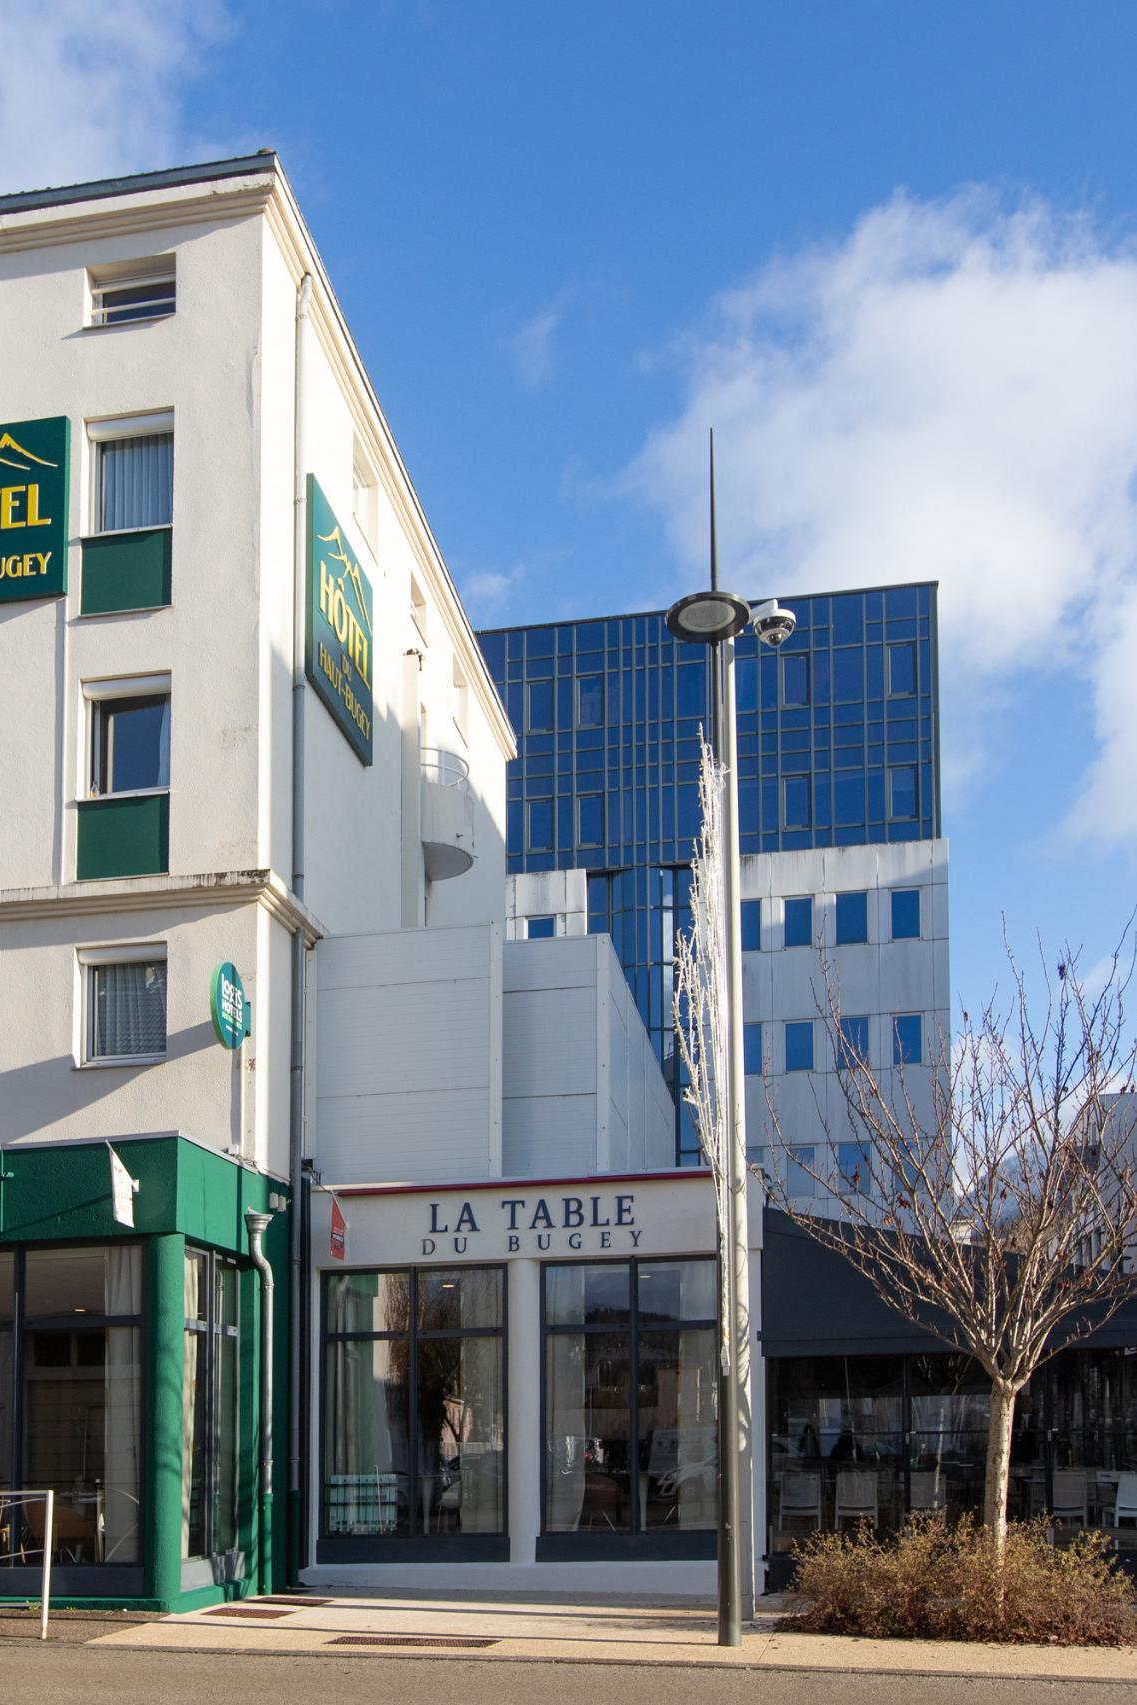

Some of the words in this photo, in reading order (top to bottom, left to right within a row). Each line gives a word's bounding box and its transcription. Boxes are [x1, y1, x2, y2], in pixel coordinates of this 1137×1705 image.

[319, 560, 371, 690] HÔTEL
[341, 654, 352, 681] DU
[318, 641, 370, 741] HAUT-BUGEY
[429, 1202, 481, 1233] LA
[501, 1195, 635, 1230] TABLE
[421, 1237, 468, 1256] DU
[507, 1230, 643, 1252] BUGEY
